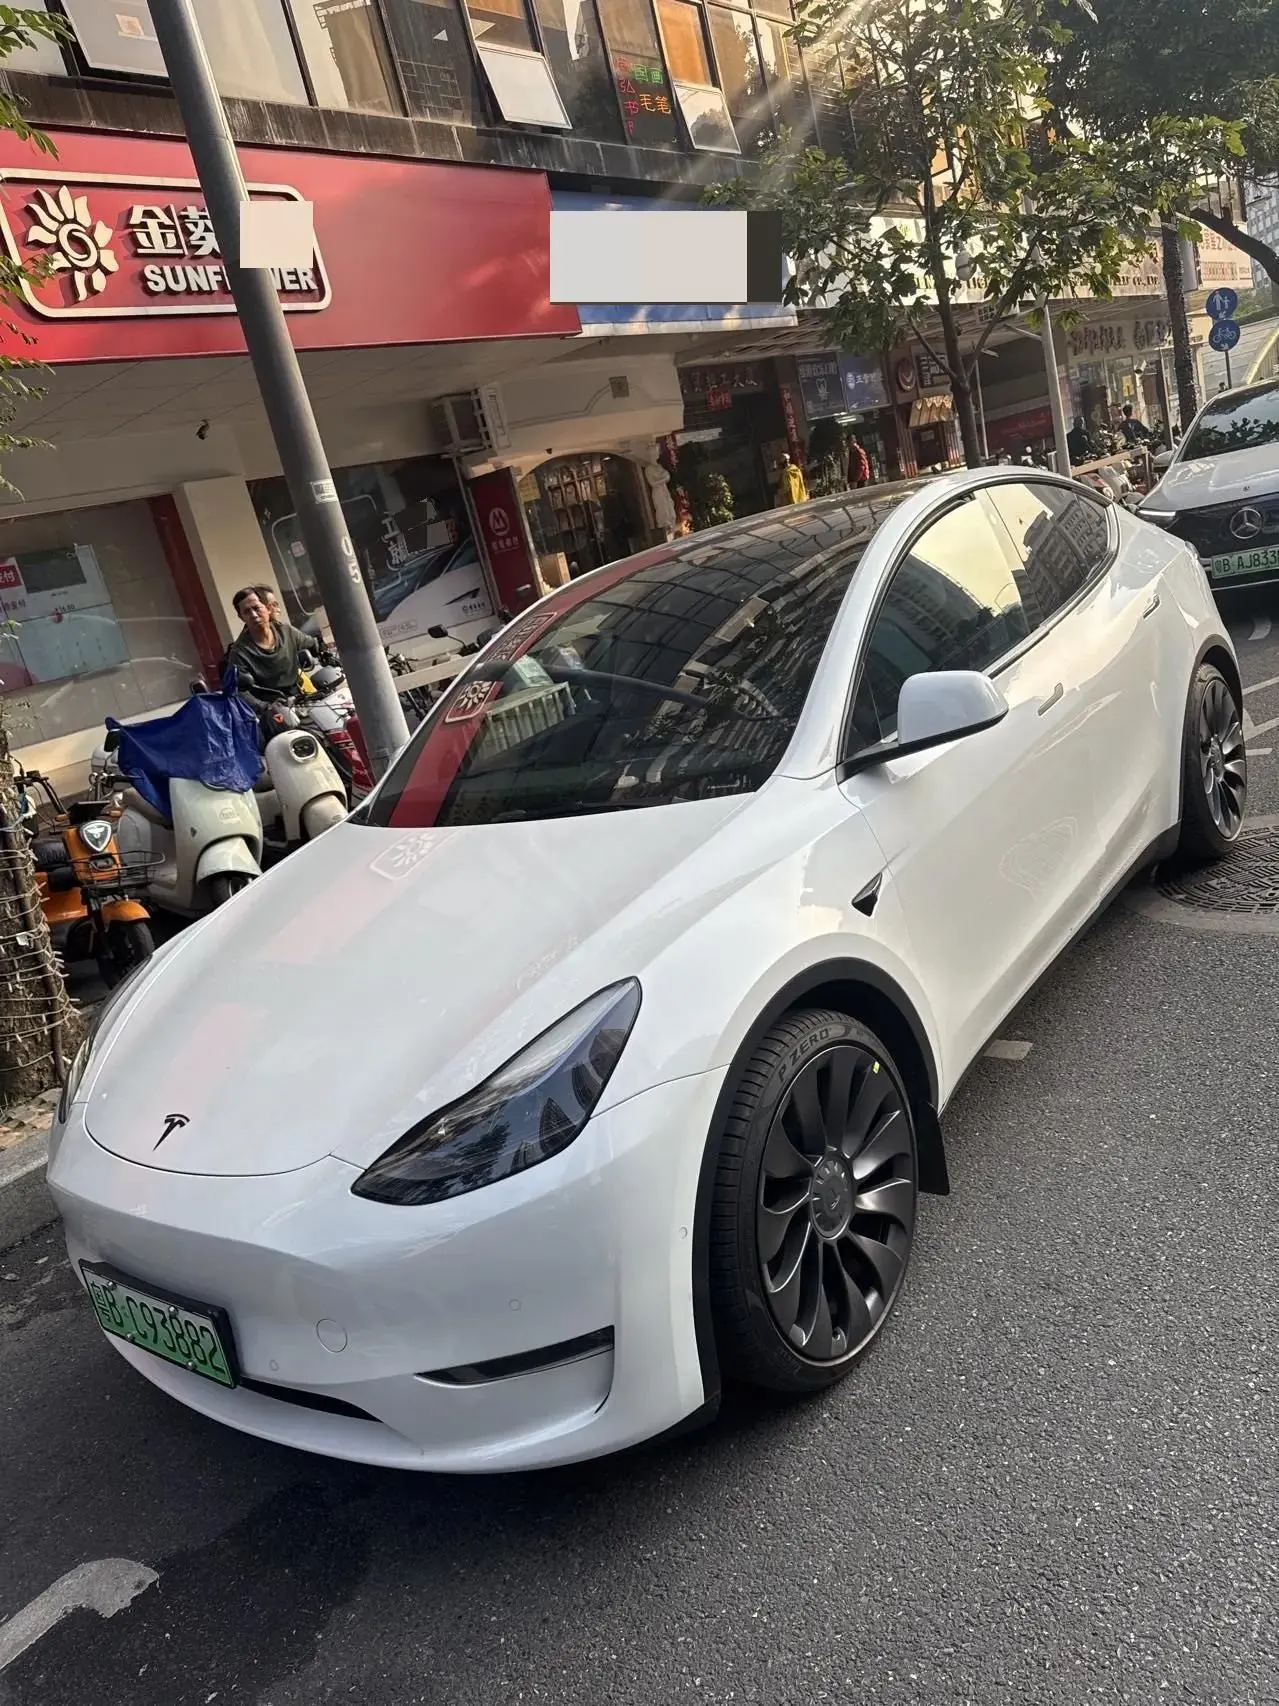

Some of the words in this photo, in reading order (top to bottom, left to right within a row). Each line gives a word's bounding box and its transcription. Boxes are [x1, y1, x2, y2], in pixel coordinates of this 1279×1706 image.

[639, 94, 672, 115] 毛笔
[778, 1063, 788, 1081] P
[788, 1028, 829, 1066] ZERO
